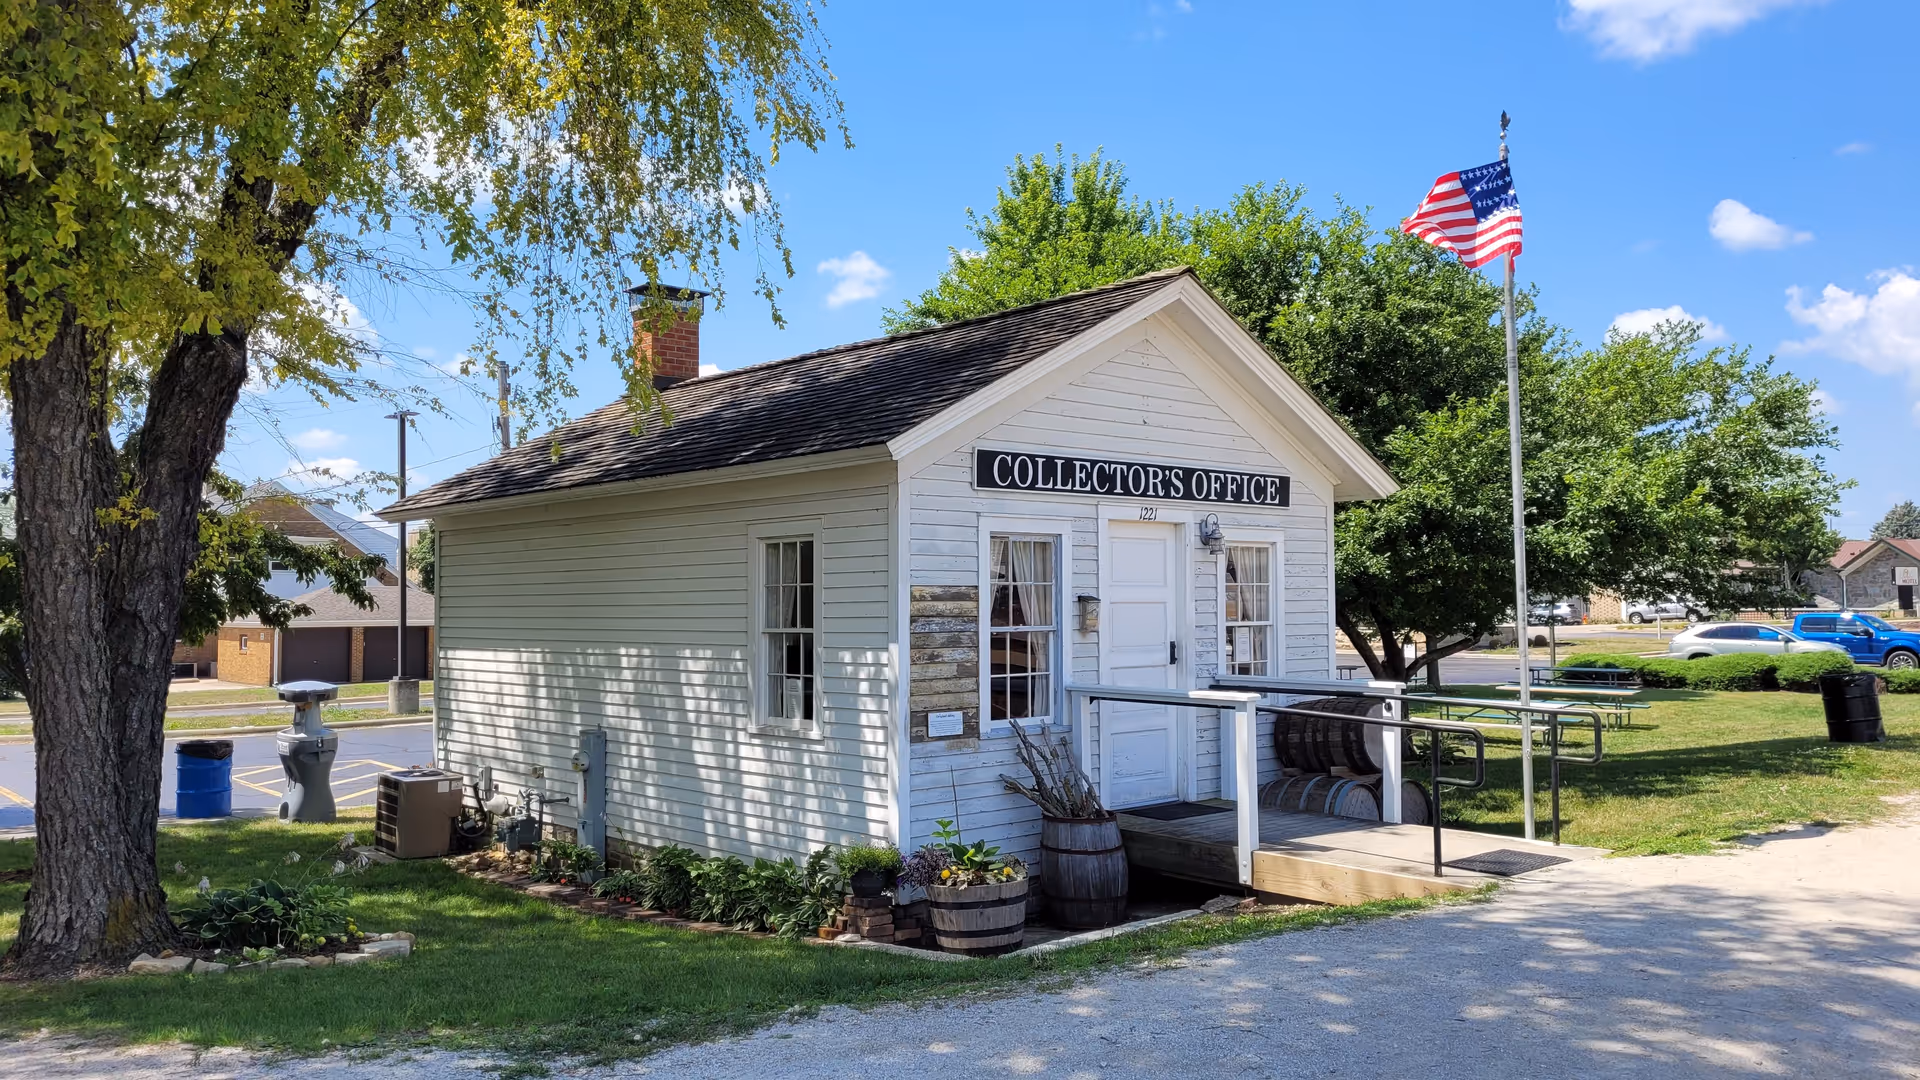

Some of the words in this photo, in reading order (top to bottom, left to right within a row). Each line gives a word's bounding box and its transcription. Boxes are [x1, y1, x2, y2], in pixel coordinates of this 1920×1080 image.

[993, 454, 1184, 498] COLLECTOR'S
[1192, 471, 1280, 504] OFFICE
[1139, 507, 1157, 521] 1221
